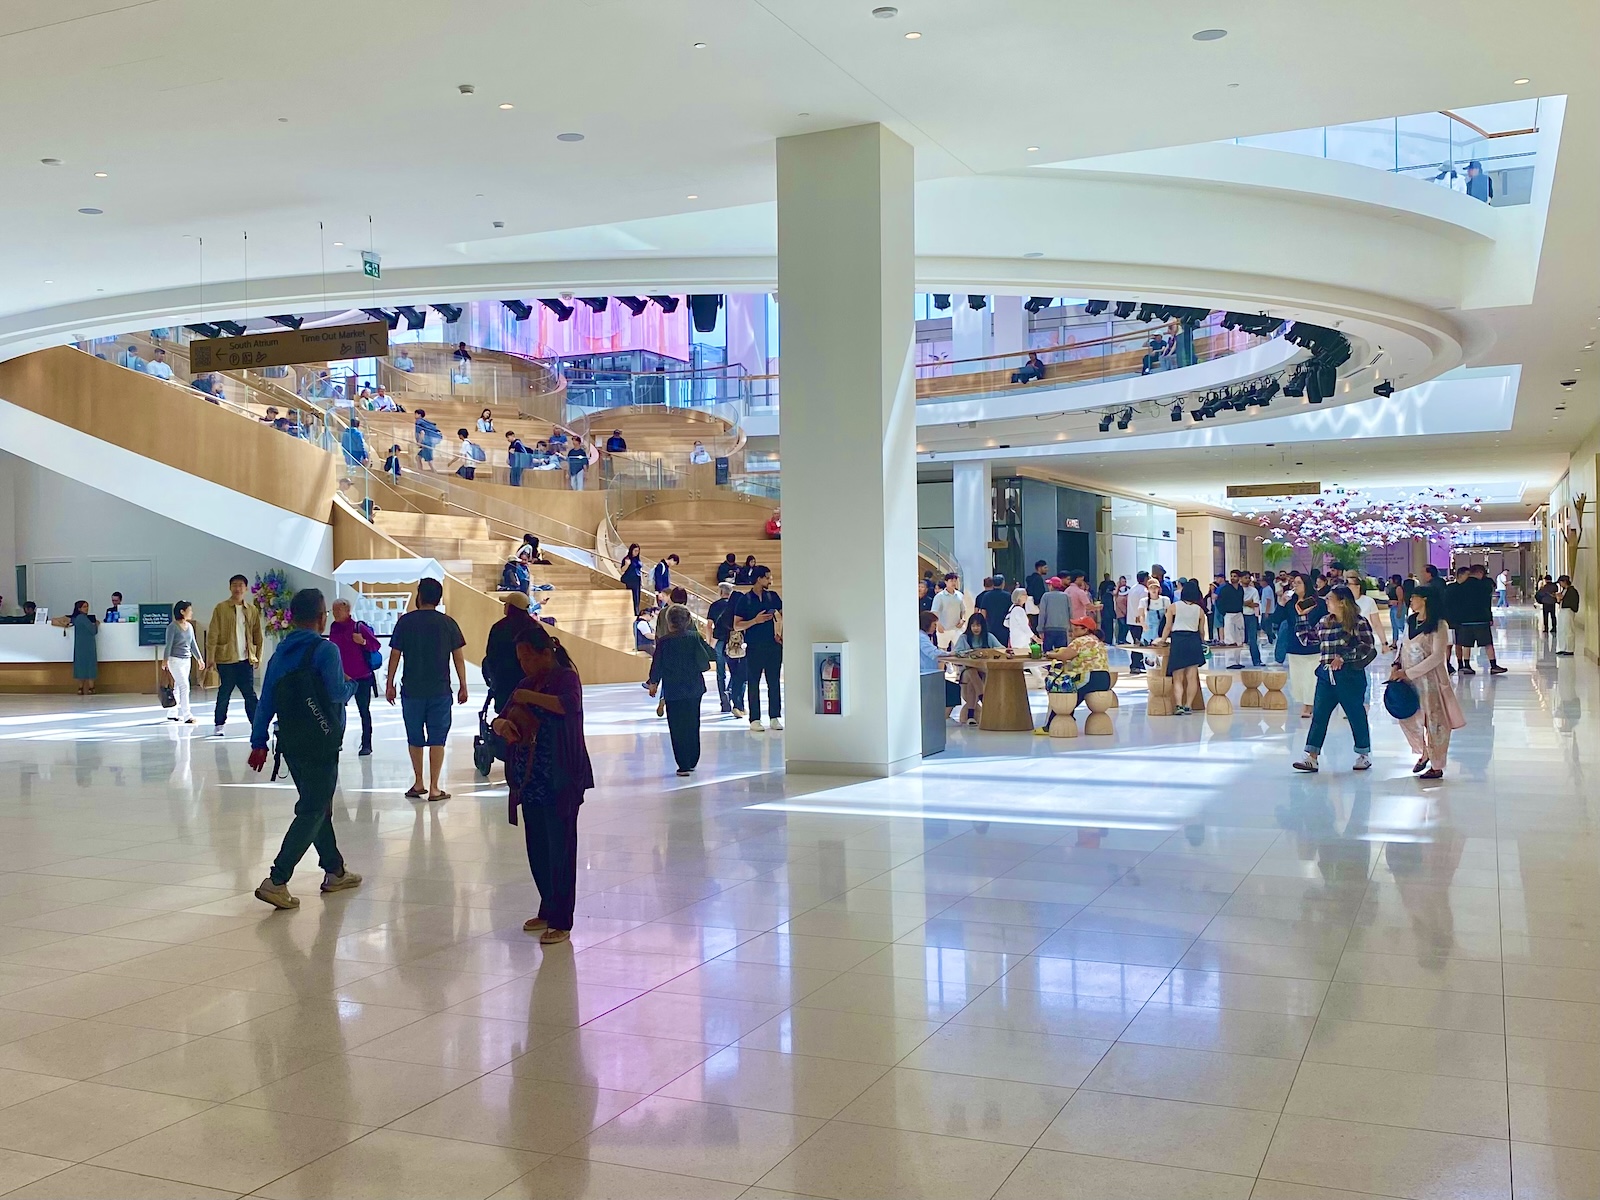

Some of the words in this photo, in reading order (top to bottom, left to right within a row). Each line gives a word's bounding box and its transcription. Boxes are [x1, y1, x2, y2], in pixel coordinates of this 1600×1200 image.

[301, 334, 320, 343] Time
[321, 332, 337, 341] Out
[339, 329, 366, 340] Market
[229, 340, 252, 350] South
[253, 339, 279, 348] Atrium
[305, 697, 331, 735] NAUTICA
